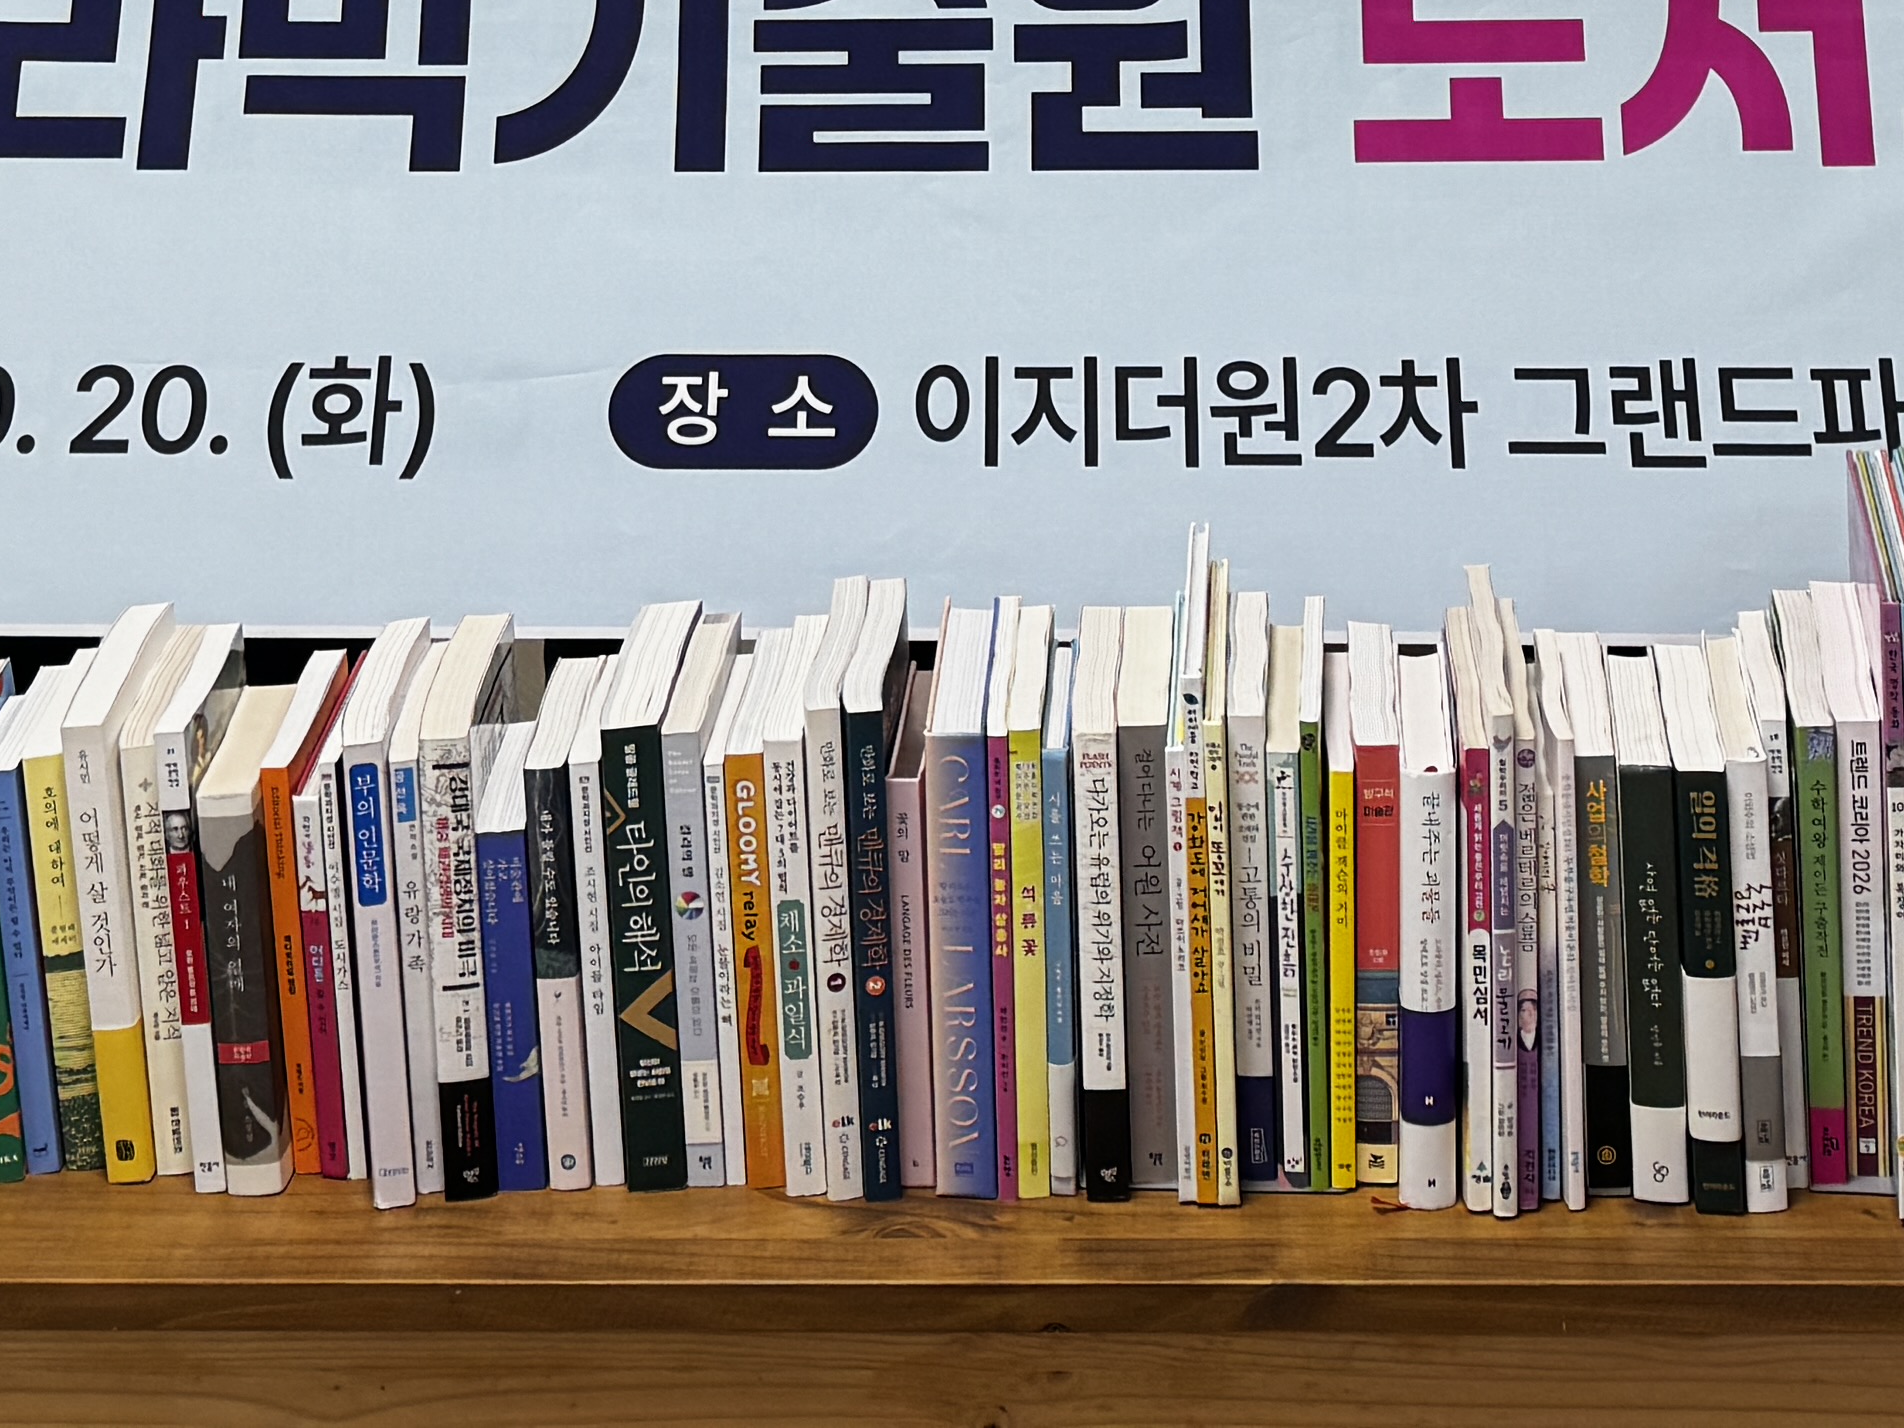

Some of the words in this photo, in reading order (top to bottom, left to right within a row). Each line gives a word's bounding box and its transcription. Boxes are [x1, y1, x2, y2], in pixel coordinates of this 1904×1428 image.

[68, 363, 228, 455] 20.
[266, 354, 435, 480] (화)
[914, 355, 1479, 470] 이지더원2차
[818, 740, 837, 784] 만화로
[859, 744, 877, 787] 만화로
[1239, 743, 1254, 752] The
[1850, 738, 1870, 792] 트렌드
[42, 786, 60, 831] 호의에
[353, 775, 376, 820] 부의
[448, 775, 471, 834] 강대국
[823, 789, 836, 816] 보는
[862, 791, 880, 821] 보는
[1047, 791, 1062, 825] 시를
[1085, 777, 1111, 849] 다가오는
[1133, 748, 1156, 833] 걸어다니는
[1362, 787, 1395, 799] 방구석
[1362, 806, 1395, 818] 미술관
[1518, 781, 1537, 823] 젊은
[1891, 801, 1904, 813] 10
[144, 801, 163, 835] 지적
[539, 810, 554, 834] 내가
[734, 779, 761, 887] GLOOMY
[1420, 791, 1442, 867] 끝내주는
[1689, 790, 1720, 840] 일의
[1850, 795, 1871, 847] 코리아
[48, 839, 67, 888] 대하여
[79, 807, 104, 874] 어떻게
[147, 839, 168, 890] 대화를
[357, 827, 383, 894] 인문학
[541, 837, 556, 864] 틀릴
[615, 820, 657, 908] 타인의
[679, 824, 693, 862] 컬러의
[817, 822, 845, 891] 맨큐의
[857, 827, 886, 895] 맨큐의
[1048, 834, 1064, 867] 쓰는
[1692, 845, 1719, 870] 격
[86, 881, 109, 905] 살
[222, 874, 236, 892] 내
[452, 838, 477, 935] 국제정치의
[541, 866, 557, 893] 수도
[1049, 875, 1064, 907] 마음
[1089, 851, 1112, 906] 유럽의
[1132, 844, 1163, 898] 어원
[1277, 847, 1298, 923] 수상한
[1519, 828, 1538, 911] 베르테르의
[1639, 862, 1659, 893] 사연
[1693, 873, 1720, 899] 格
[1851, 849, 1873, 896] 2026
[151, 892, 174, 927] 위한
[545, 898, 561, 945] 있습니다
[741, 891, 759, 942] relay
[900, 894, 911, 945] LANGAGE
[1237, 865, 1263, 933] 고통의
[1420, 873, 1442, 925] 괴물들
[1638, 898, 1663, 925] 없는
[91, 911, 118, 978] 것인가
[154, 933, 175, 966] 넓고
[223, 899, 242, 952] 여자의
[402, 880, 426, 973] 유랑가족
[621, 913, 662, 972] 해석
[779, 909, 806, 955] 채소
[820, 895, 850, 968] 경제학
[859, 898, 890, 971] 경제학
[1091, 909, 1114, 967] 위기와
[1134, 904, 1164, 957] 사전
[1520, 912, 1536, 953] 슬픔
[334, 940, 350, 990] 도시가스
[457, 937, 478, 979] 비극
[903, 948, 912, 967] DES
[1242, 939, 1264, 987] 비밀
[1643, 930, 1665, 972] 단어는
[157, 969, 177, 1002] 얕은
[904, 969, 914, 1010] FLEURS
[1091, 967, 1116, 1024] 지정학
[1472, 943, 1489, 1026] 목민심서
[1642, 978, 1663, 1009] 없다
[160, 1006, 183, 1041] 지식
[783, 975, 808, 1052] 과일식
[1856, 1004, 1876, 1064] TREND
[1857, 1068, 1876, 1129] KOREA
